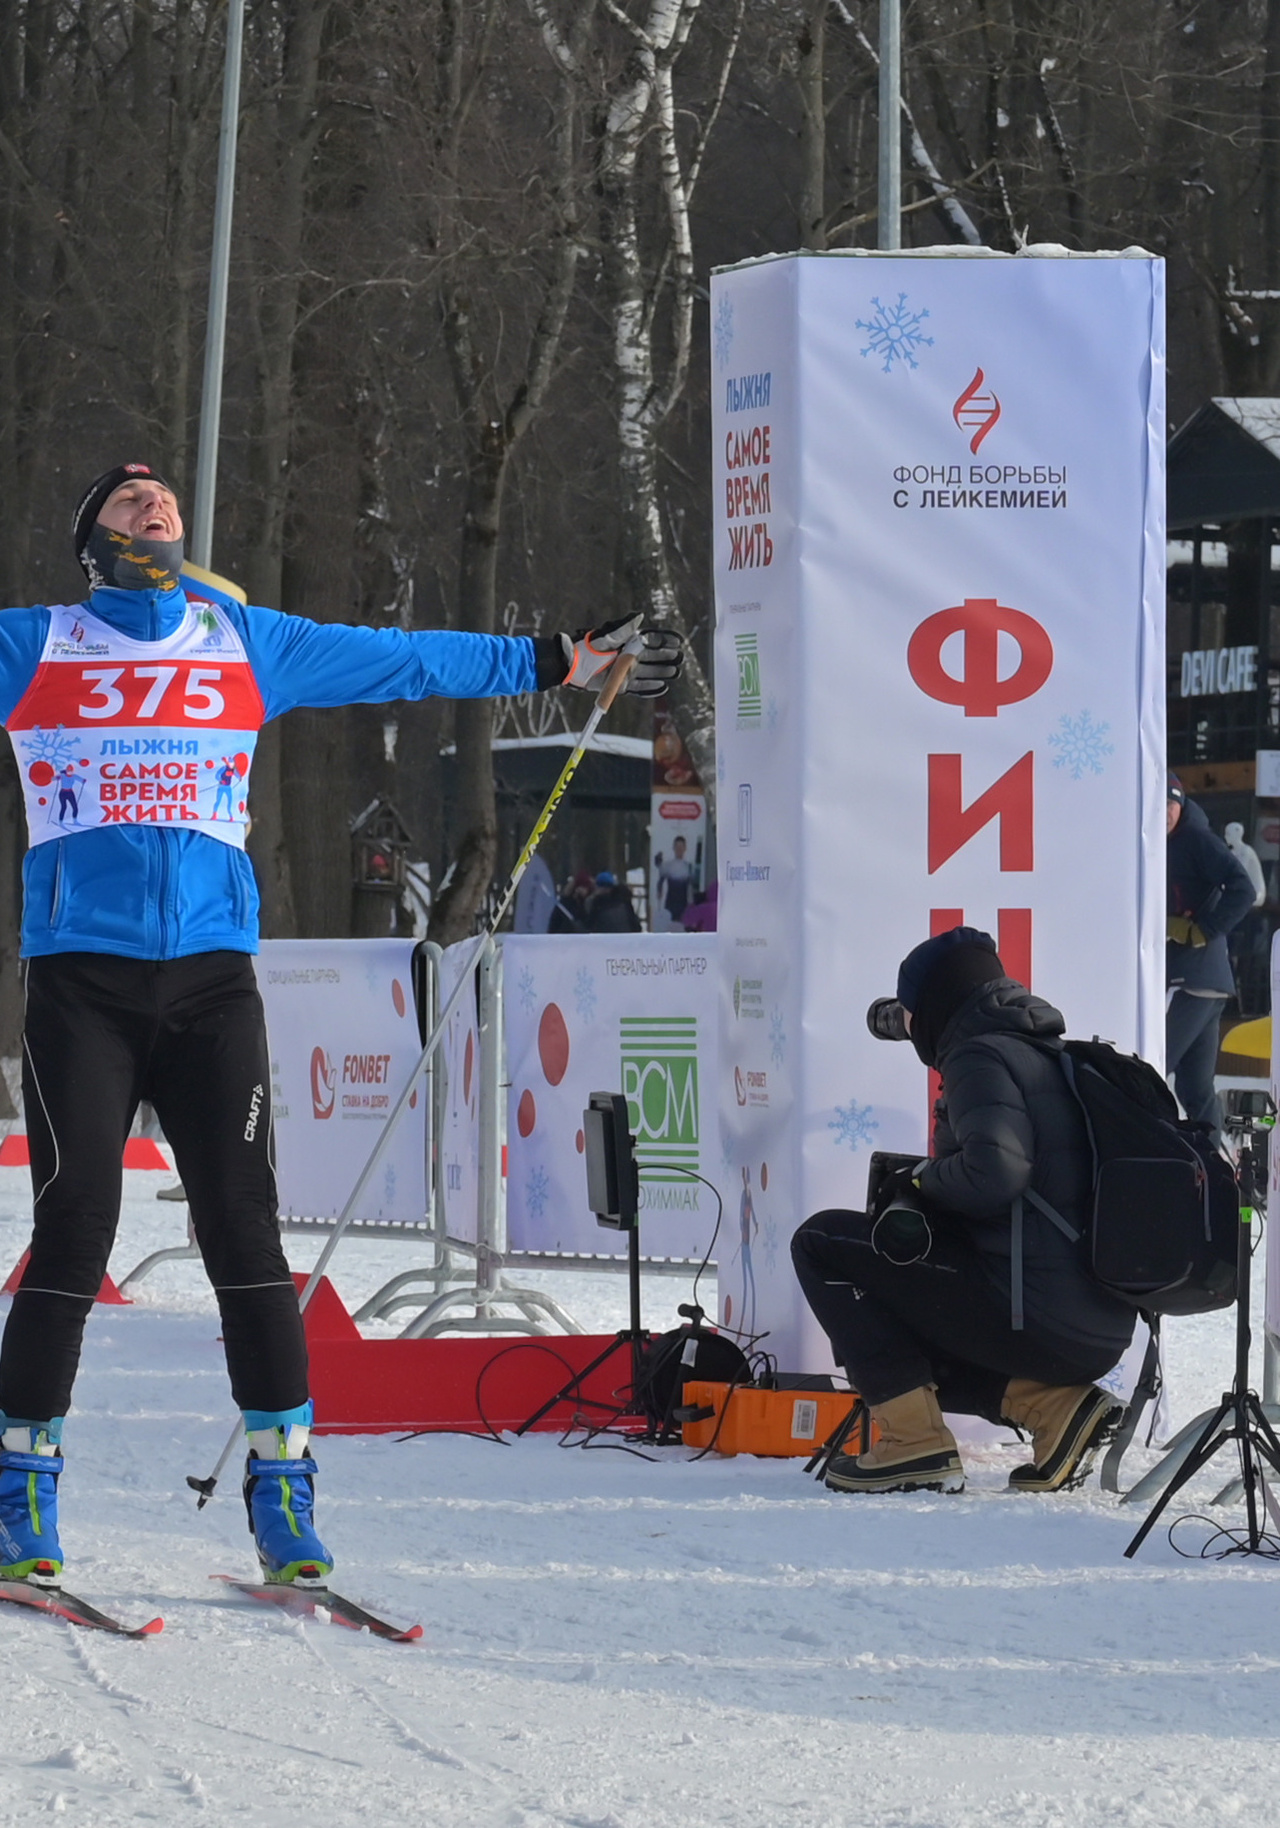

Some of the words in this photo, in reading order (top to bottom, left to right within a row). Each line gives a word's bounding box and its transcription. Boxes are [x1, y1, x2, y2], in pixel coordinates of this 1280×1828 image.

[726, 372, 771, 413] ЛЫЖНЯ
[726, 426, 771, 470] САМОЕ
[893, 465, 962, 487] ФОНД
[970, 465, 1066, 484] БОРЬБЫ
[726, 473, 771, 519] ВРЕМЯ
[893, 489, 909, 508] С
[920, 485, 1067, 508] ЛЕЙКЕМИЕЙ
[728, 523, 774, 571] ЖИТЬ
[1181, 650, 1216, 698] DEVI
[1218, 645, 1258, 694] CAFE
[78, 666, 225, 720] 375
[100, 740, 199, 756] ЛЫЖНЯ
[99, 762, 198, 780] САМОЕ
[99, 782, 197, 801] ВРЕМЯ
[99, 804, 200, 823] ЖИТЬ
[606, 953, 667, 976] ГЕНЕРАЛЬНЫЙ
[668, 957, 707, 975] ПАРТНЕР
[342, 1054, 391, 1084] FONBET
[244, 1092, 262, 1142] CRAFT
